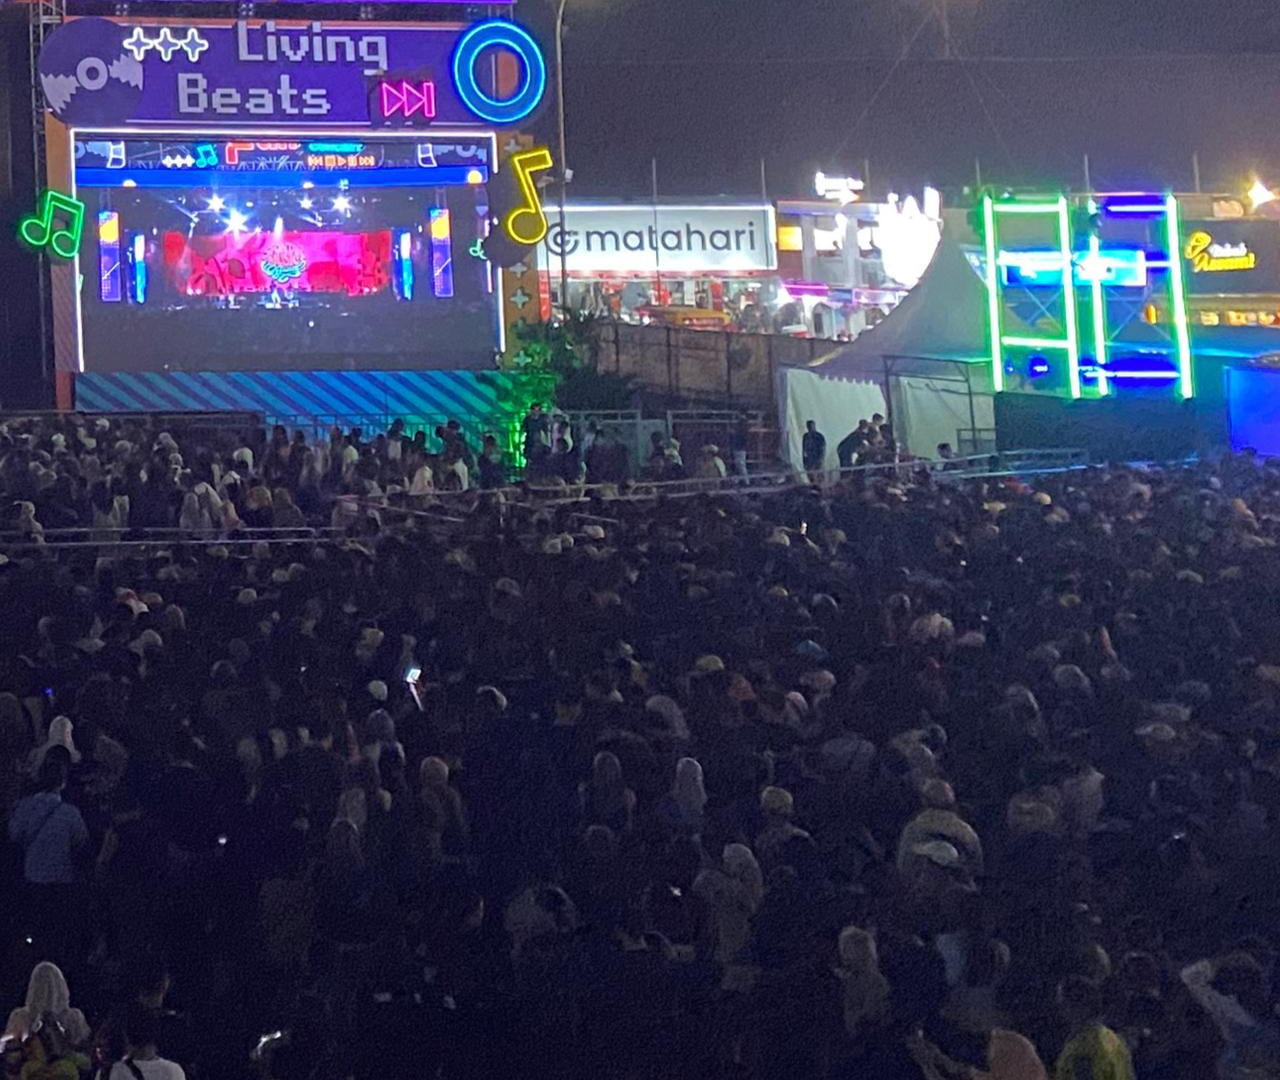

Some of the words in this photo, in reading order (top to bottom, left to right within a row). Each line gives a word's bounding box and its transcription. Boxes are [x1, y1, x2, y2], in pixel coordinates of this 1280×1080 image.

[237, 21, 388, 74] Living
[177, 72, 331, 116] Beats
[586, 220, 756, 253] matahari
